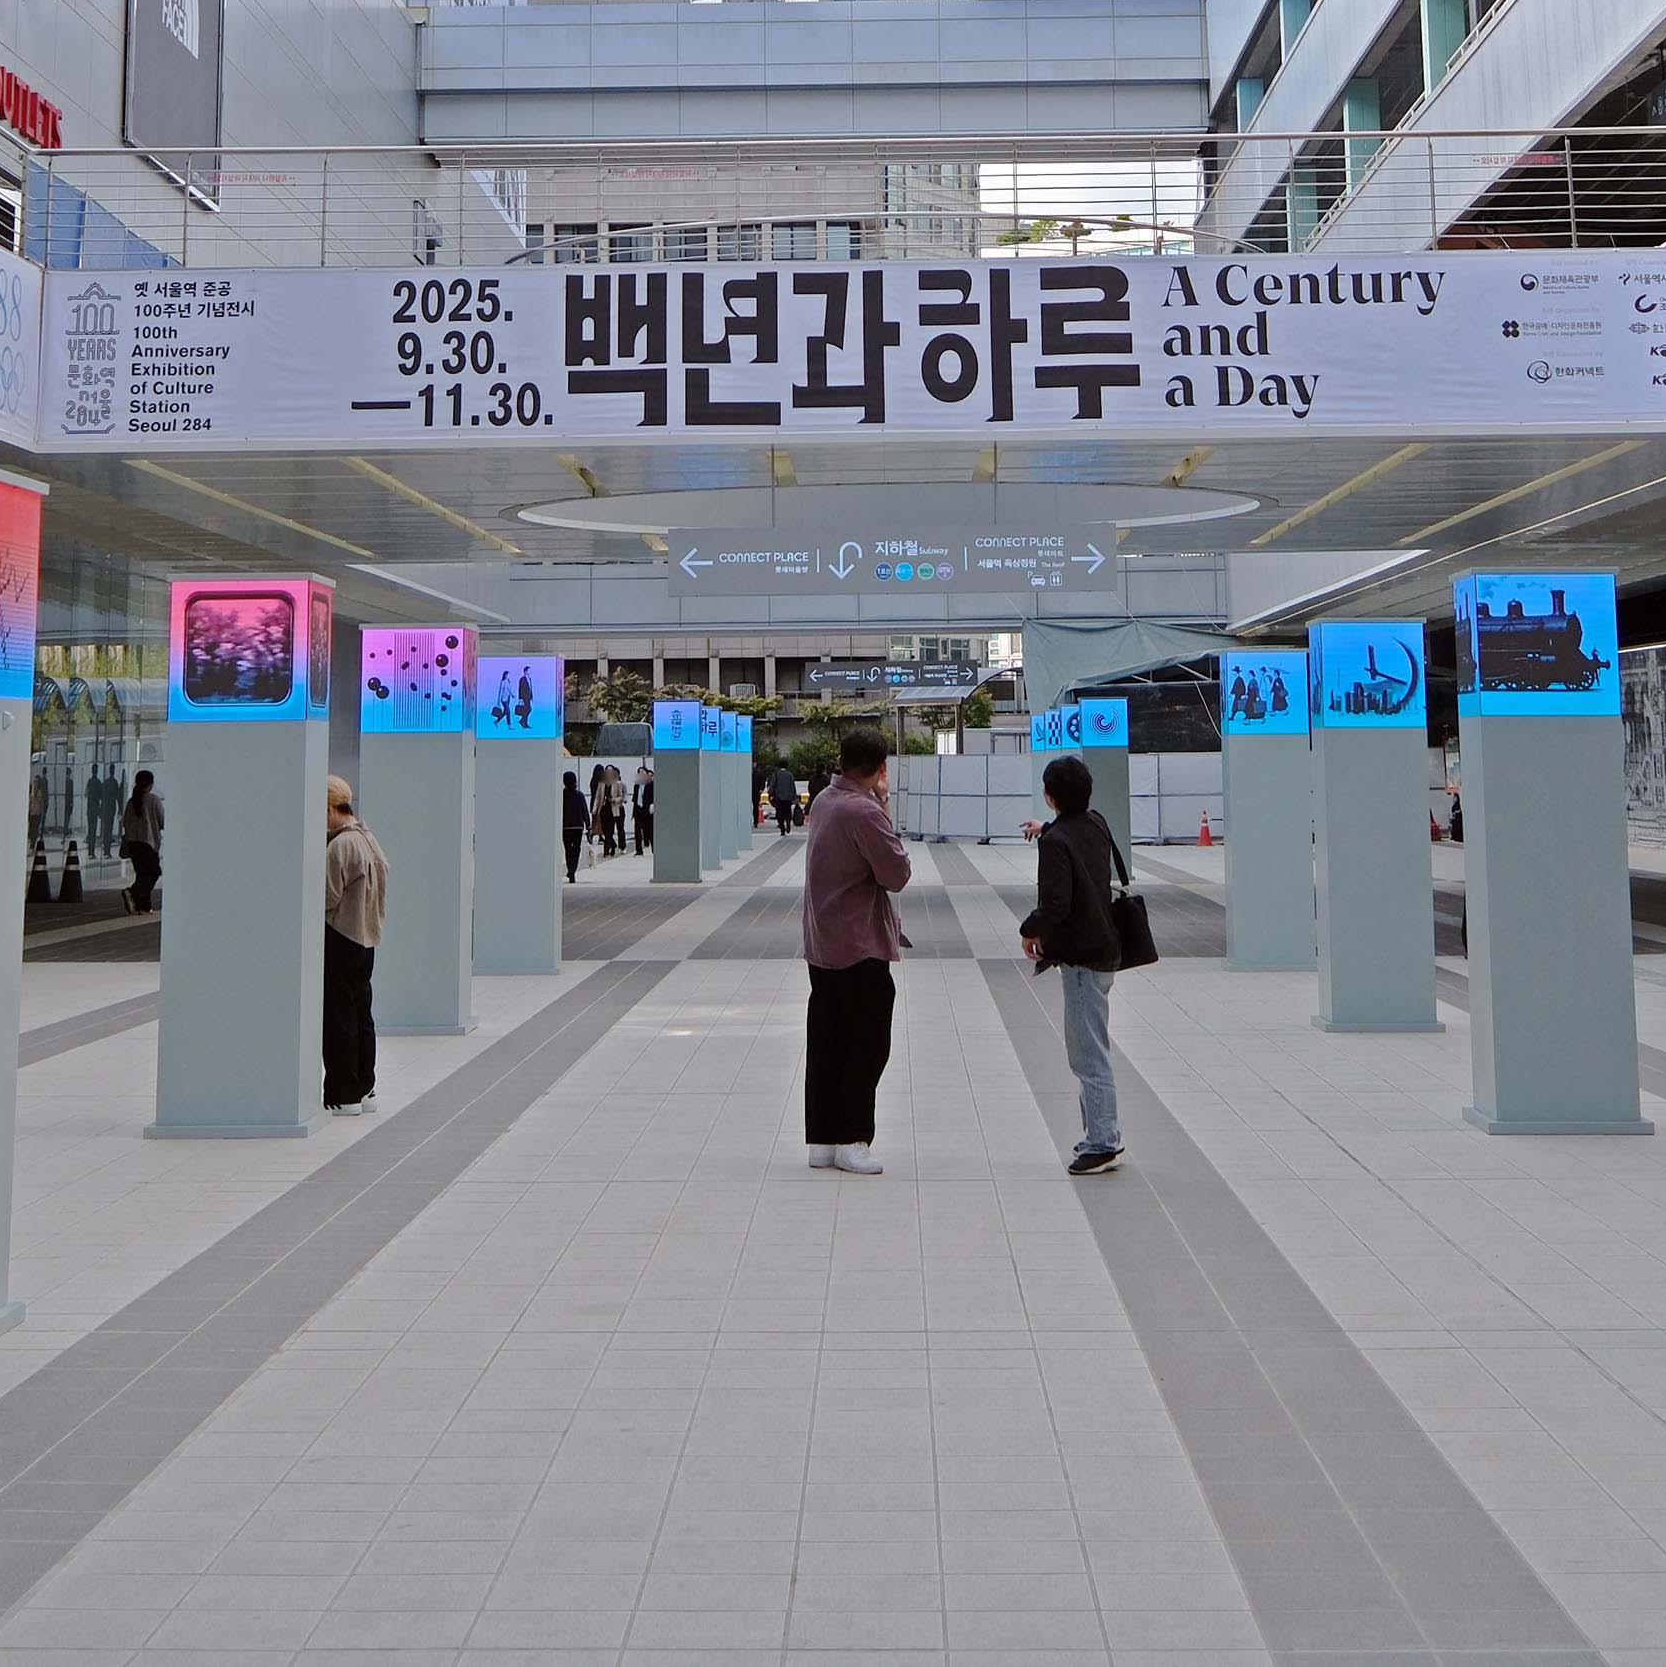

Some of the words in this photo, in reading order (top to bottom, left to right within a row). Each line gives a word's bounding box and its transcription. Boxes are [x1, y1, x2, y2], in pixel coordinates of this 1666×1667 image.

[134, 282, 148, 297] 옛
[154, 282, 197, 298] 서울역
[203, 281, 232, 297] 준공
[1162, 265, 1200, 307] A
[1215, 263, 1445, 316] Century
[392, 279, 513, 324] 2025.
[134, 303, 191, 319] 100주년
[197, 300, 255, 318] 기념전시
[134, 326, 178, 339] 100th
[1162, 310, 1271, 357] and
[68, 338, 116, 361] YEARS
[131, 345, 230, 359] Anniversary
[397, 330, 507, 376] 9.30.
[131, 363, 215, 376] Exhibition
[1555, 366, 1605, 377] 한화커넥트
[130, 381, 148, 395] of
[153, 382, 214, 395] Culture
[1165, 375, 1196, 408] a
[1214, 365, 1320, 419] Day
[129, 400, 190, 413] Station
[128, 418, 177, 432] Seoul
[182, 418, 212, 431] 284
[874, 540, 918, 556] 지하철
[975, 537, 1027, 548] CONNECT
[1029, 537, 1064, 547] PLACE
[719, 552, 771, 563] CONNECT
[773, 552, 809, 563] PLACE
